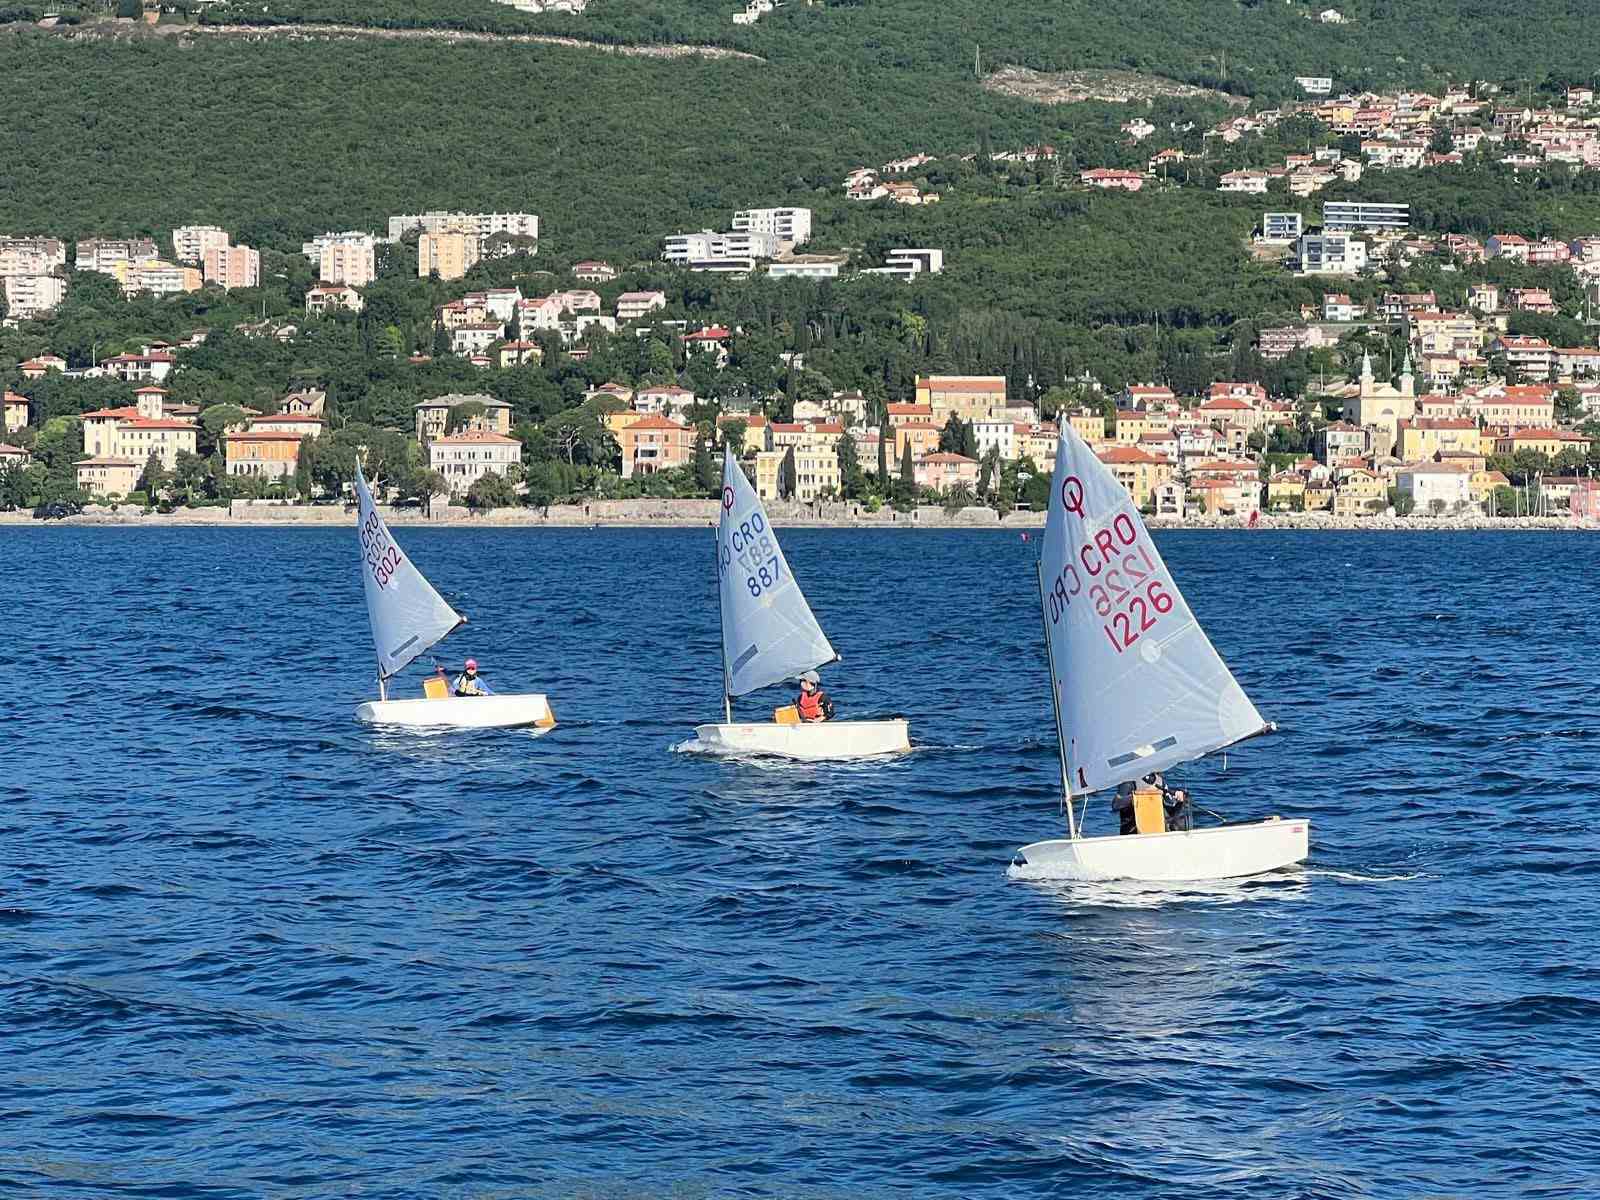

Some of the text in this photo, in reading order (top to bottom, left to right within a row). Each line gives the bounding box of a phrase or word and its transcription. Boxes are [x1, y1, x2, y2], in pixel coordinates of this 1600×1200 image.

[361, 511, 379, 549] CRO
[732, 513, 764, 552] CRO
[1081, 513, 1137, 576] CRO
[374, 546, 402, 591] 1302
[747, 556, 779, 597] 887
[1104, 581, 1173, 653] 1226
